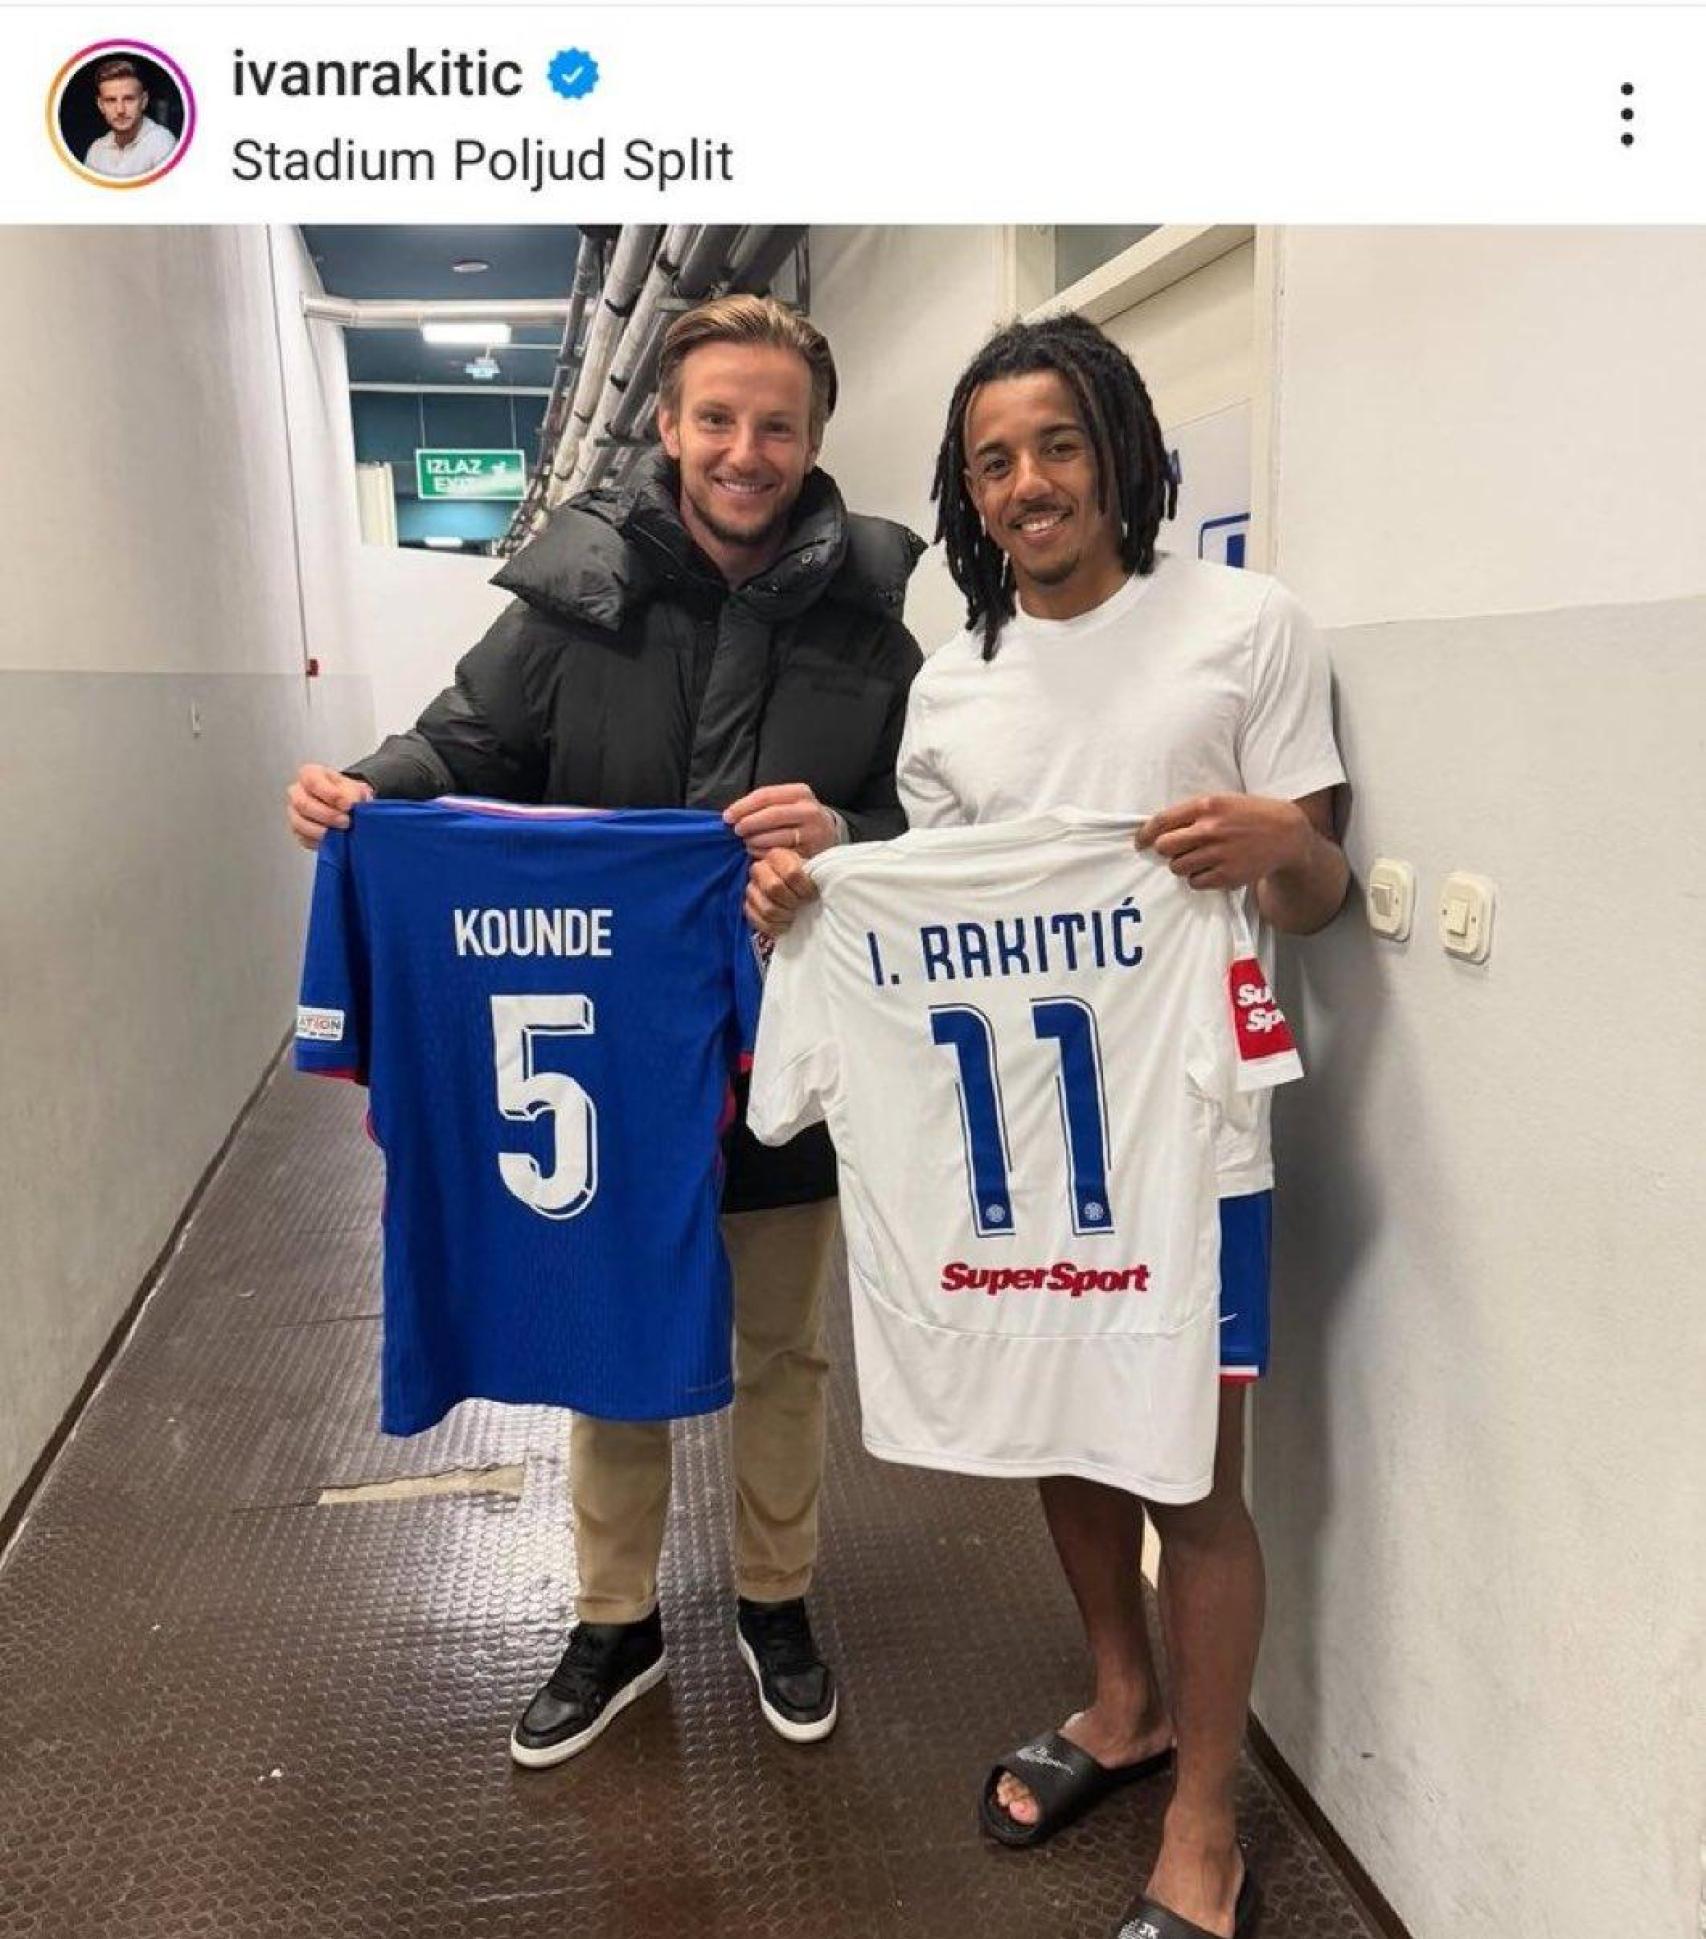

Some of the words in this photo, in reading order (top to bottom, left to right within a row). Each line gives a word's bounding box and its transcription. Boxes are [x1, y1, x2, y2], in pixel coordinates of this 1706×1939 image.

[427, 459, 482, 474] IZLAZ
[454, 908, 613, 957] KOUNDE
[867, 931, 901, 987] I.
[920, 896, 1143, 983] RAKITIĆ
[490, 994, 599, 1221] 5
[928, 996, 1115, 1238] 11
[941, 1260, 1152, 1298] SuperSport
